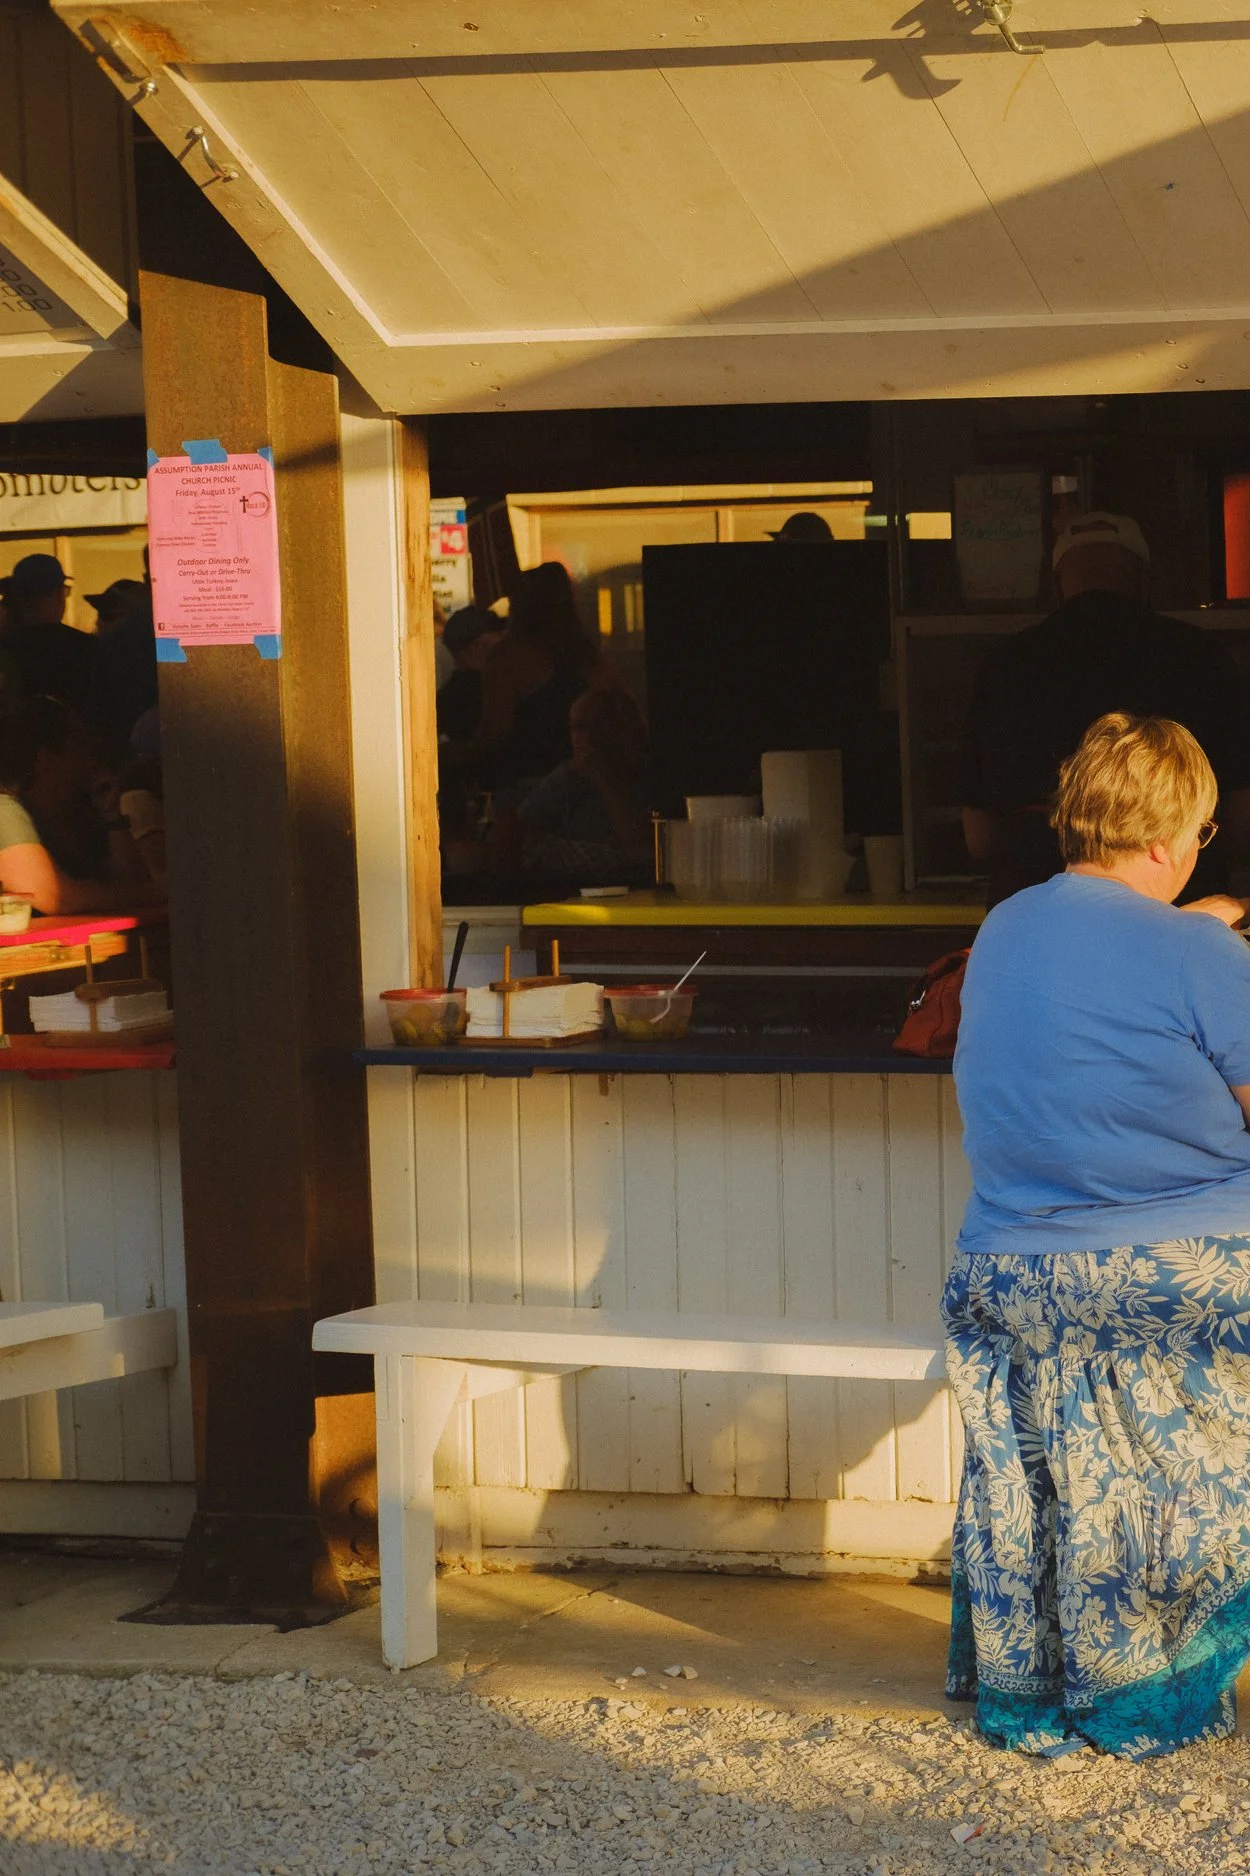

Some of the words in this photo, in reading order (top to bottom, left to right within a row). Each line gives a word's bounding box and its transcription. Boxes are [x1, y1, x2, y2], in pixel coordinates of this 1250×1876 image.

[154, 466, 202, 475] ASSUMPTION
[205, 465, 231, 473] PARISH
[233, 463, 263, 472] ANNUAL
[181, 477, 212, 485] CHURCH
[213, 476, 237, 484] PICNIC
[175, 489, 200, 497] Friday,
[201, 488, 226, 497] August
[177, 558, 207, 567] Outdoor
[208, 557, 231, 566] Dining
[233, 556, 250, 565] Only
[178, 569, 208, 577] Carry-Out
